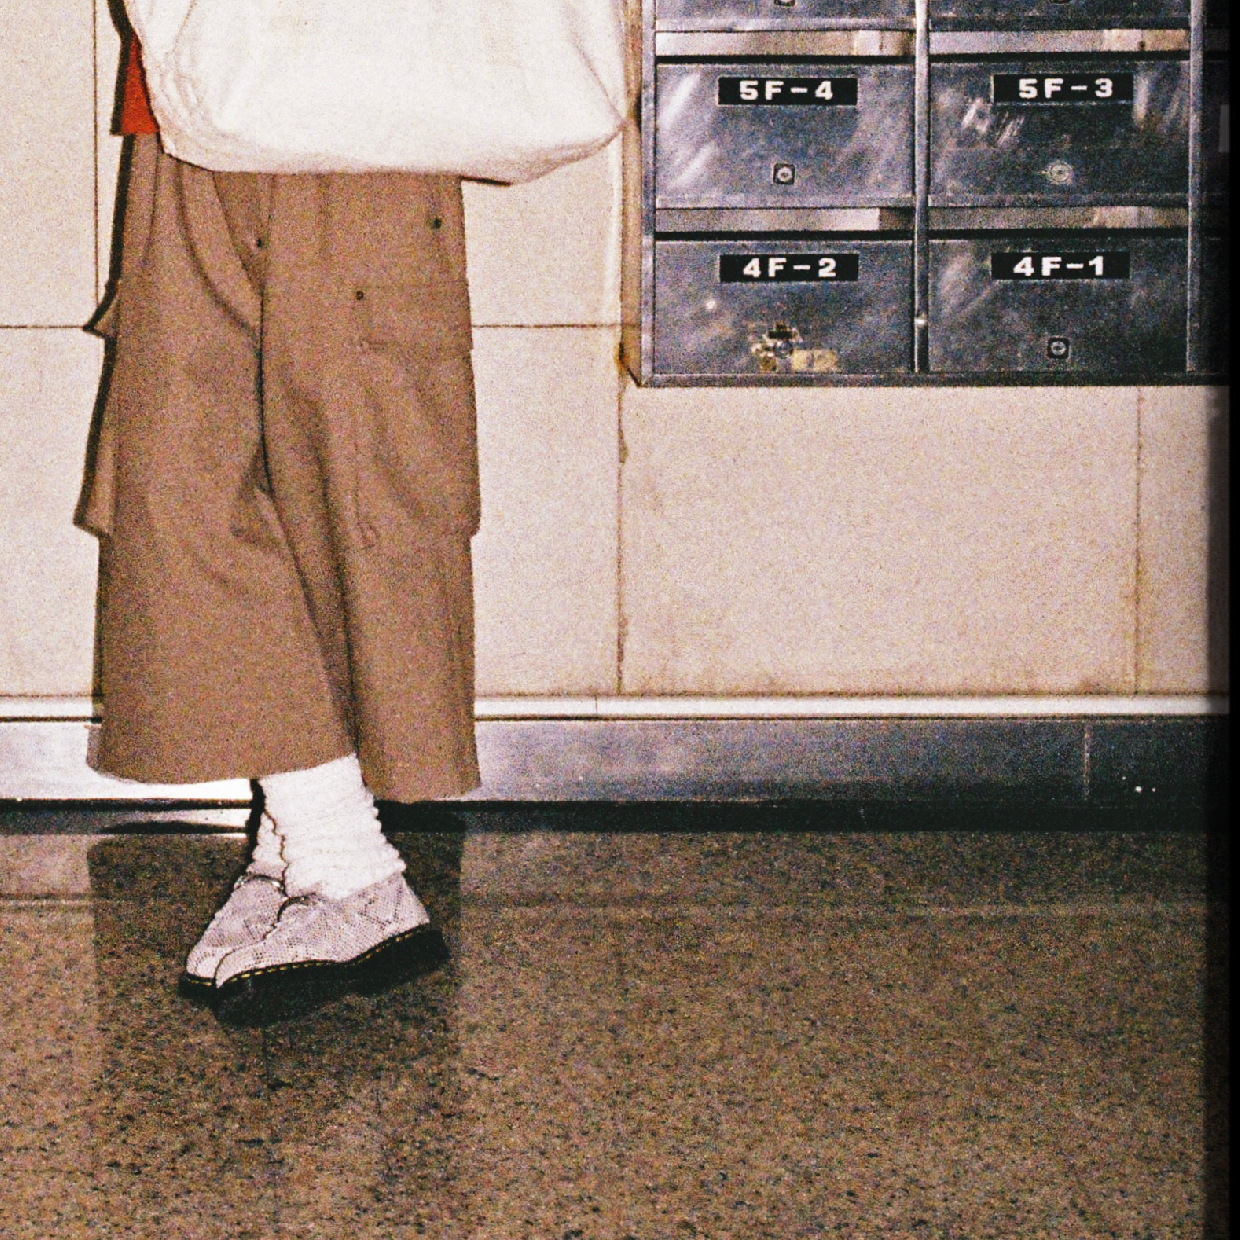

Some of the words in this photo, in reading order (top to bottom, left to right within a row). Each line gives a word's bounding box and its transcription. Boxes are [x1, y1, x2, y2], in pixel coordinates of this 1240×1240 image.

[739, 81, 834, 102] 5F-4
[1018, 78, 1114, 99] 5F-3
[743, 258, 837, 278] 4F-2
[1013, 256, 1106, 276] 4F-1
